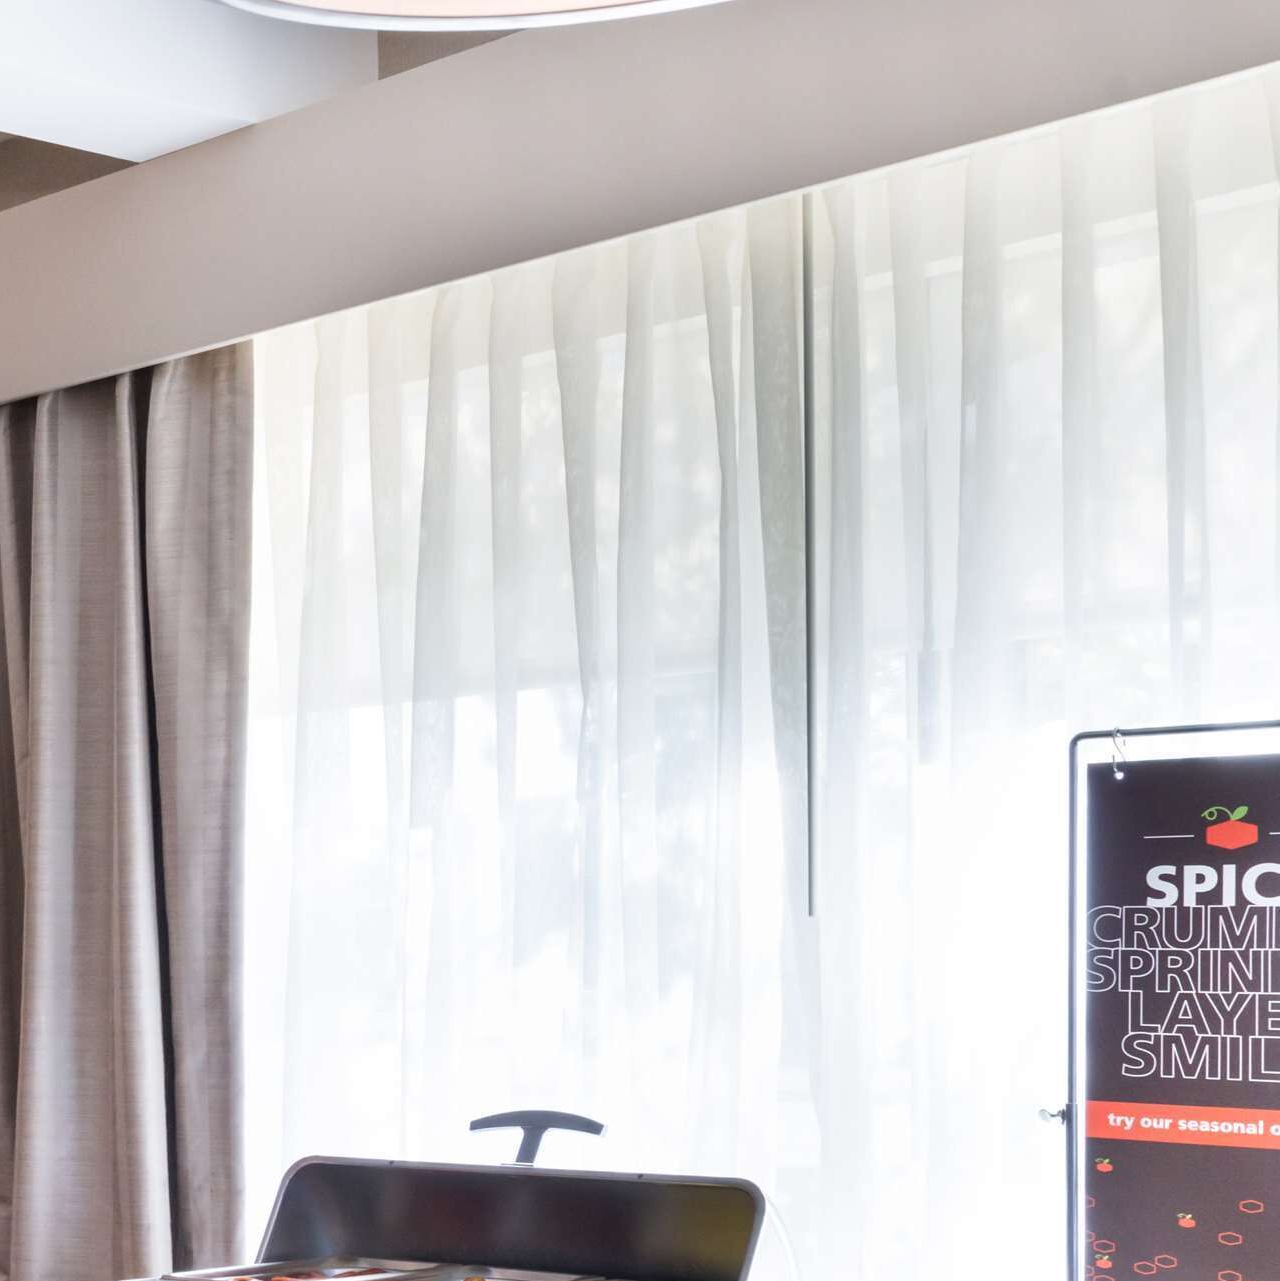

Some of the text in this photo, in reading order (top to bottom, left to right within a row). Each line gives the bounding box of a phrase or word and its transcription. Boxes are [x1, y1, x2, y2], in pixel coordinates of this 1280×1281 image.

[1145, 862, 1280, 907] SPIC
[1085, 904, 1280, 950] CRUM
[1085, 948, 1280, 993] SPRIN
[1107, 1112, 1135, 1130] try
[1140, 1117, 1172, 1130] our
[1177, 1118, 1264, 1136] seasonal
